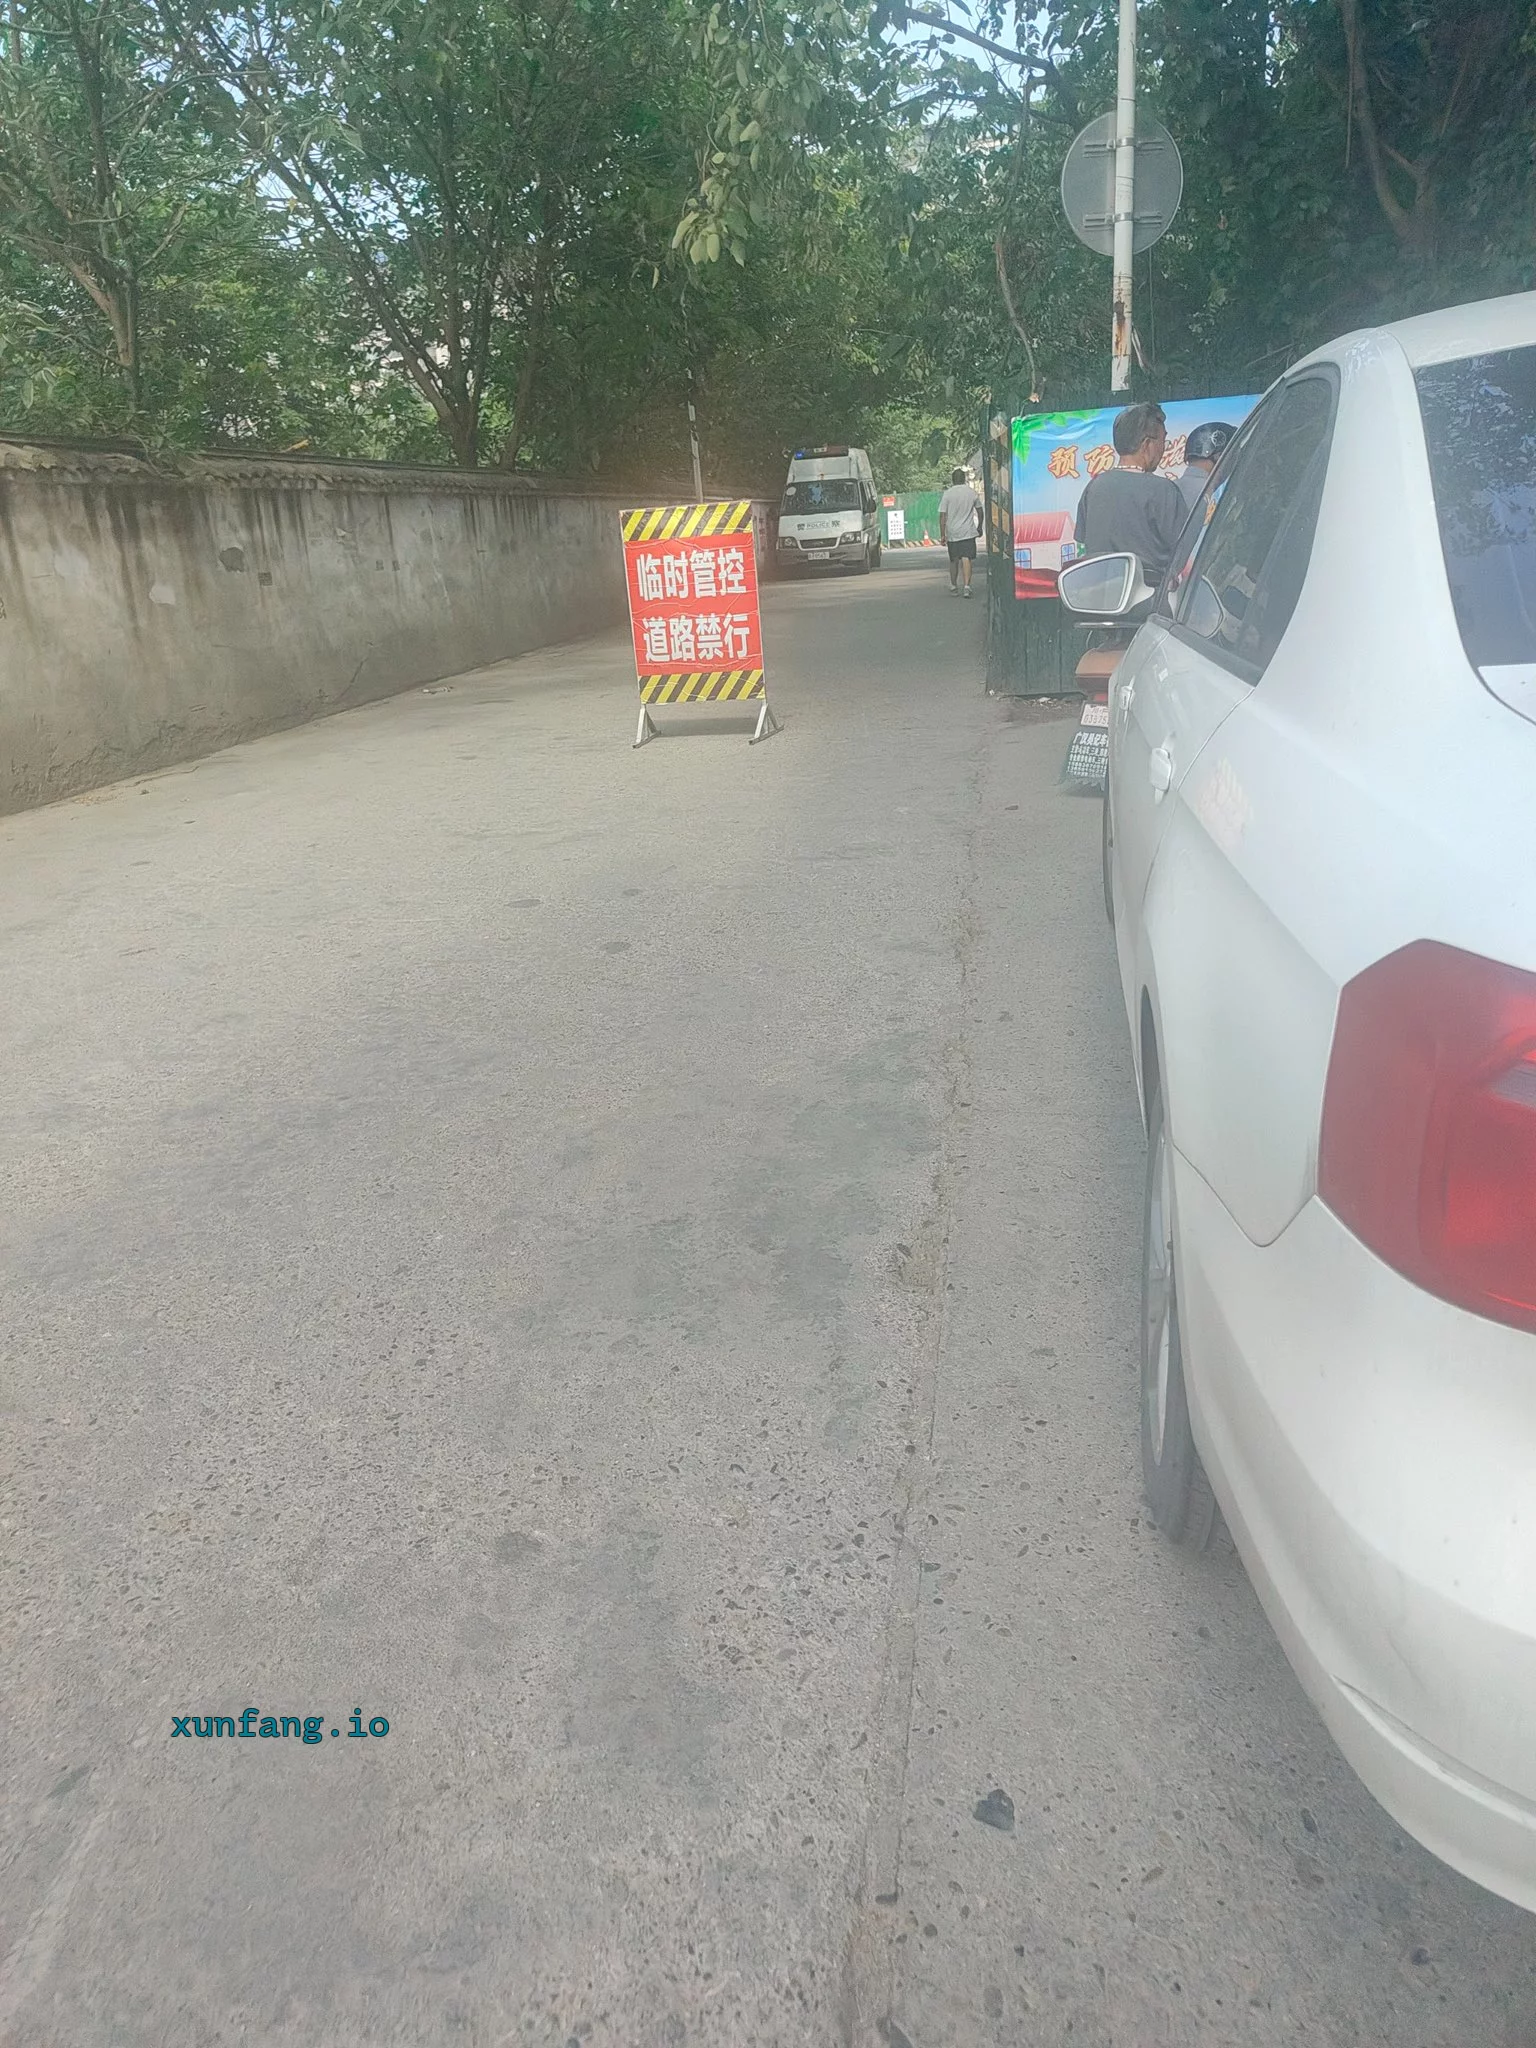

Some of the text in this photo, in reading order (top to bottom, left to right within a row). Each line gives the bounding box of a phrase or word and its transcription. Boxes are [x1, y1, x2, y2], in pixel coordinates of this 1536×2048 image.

[636, 549, 747, 601] 临时管控
[642, 612, 751, 663] 道路禁行
